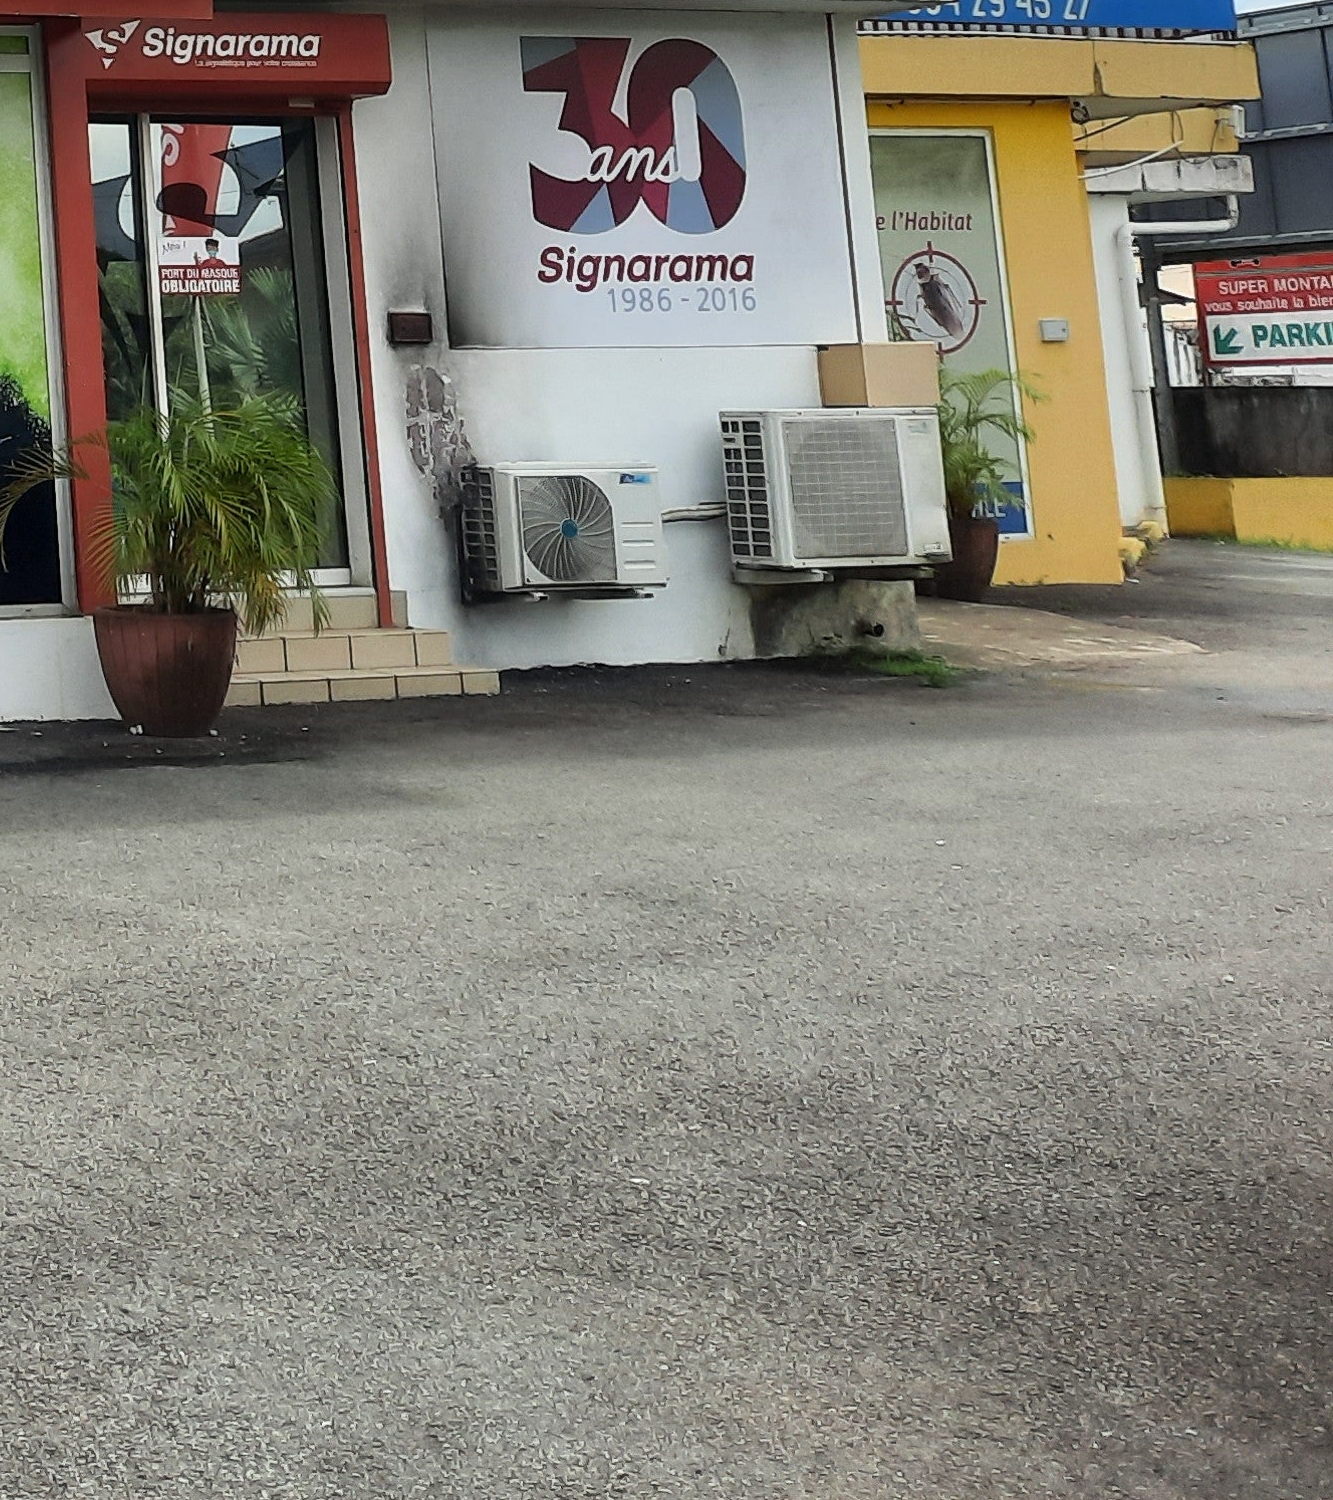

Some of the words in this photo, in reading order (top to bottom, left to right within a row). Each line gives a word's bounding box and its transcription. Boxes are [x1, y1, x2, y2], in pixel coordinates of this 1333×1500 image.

[142, 27, 320, 64] Signarama
[520, 36, 747, 235] 30
[537, 246, 755, 293] Signarama
[1218, 279, 1268, 295] SUPER
[1274, 274, 1333, 293] MONTA
[607, 287, 672, 313] 1986
[696, 287, 757, 312] 2016
